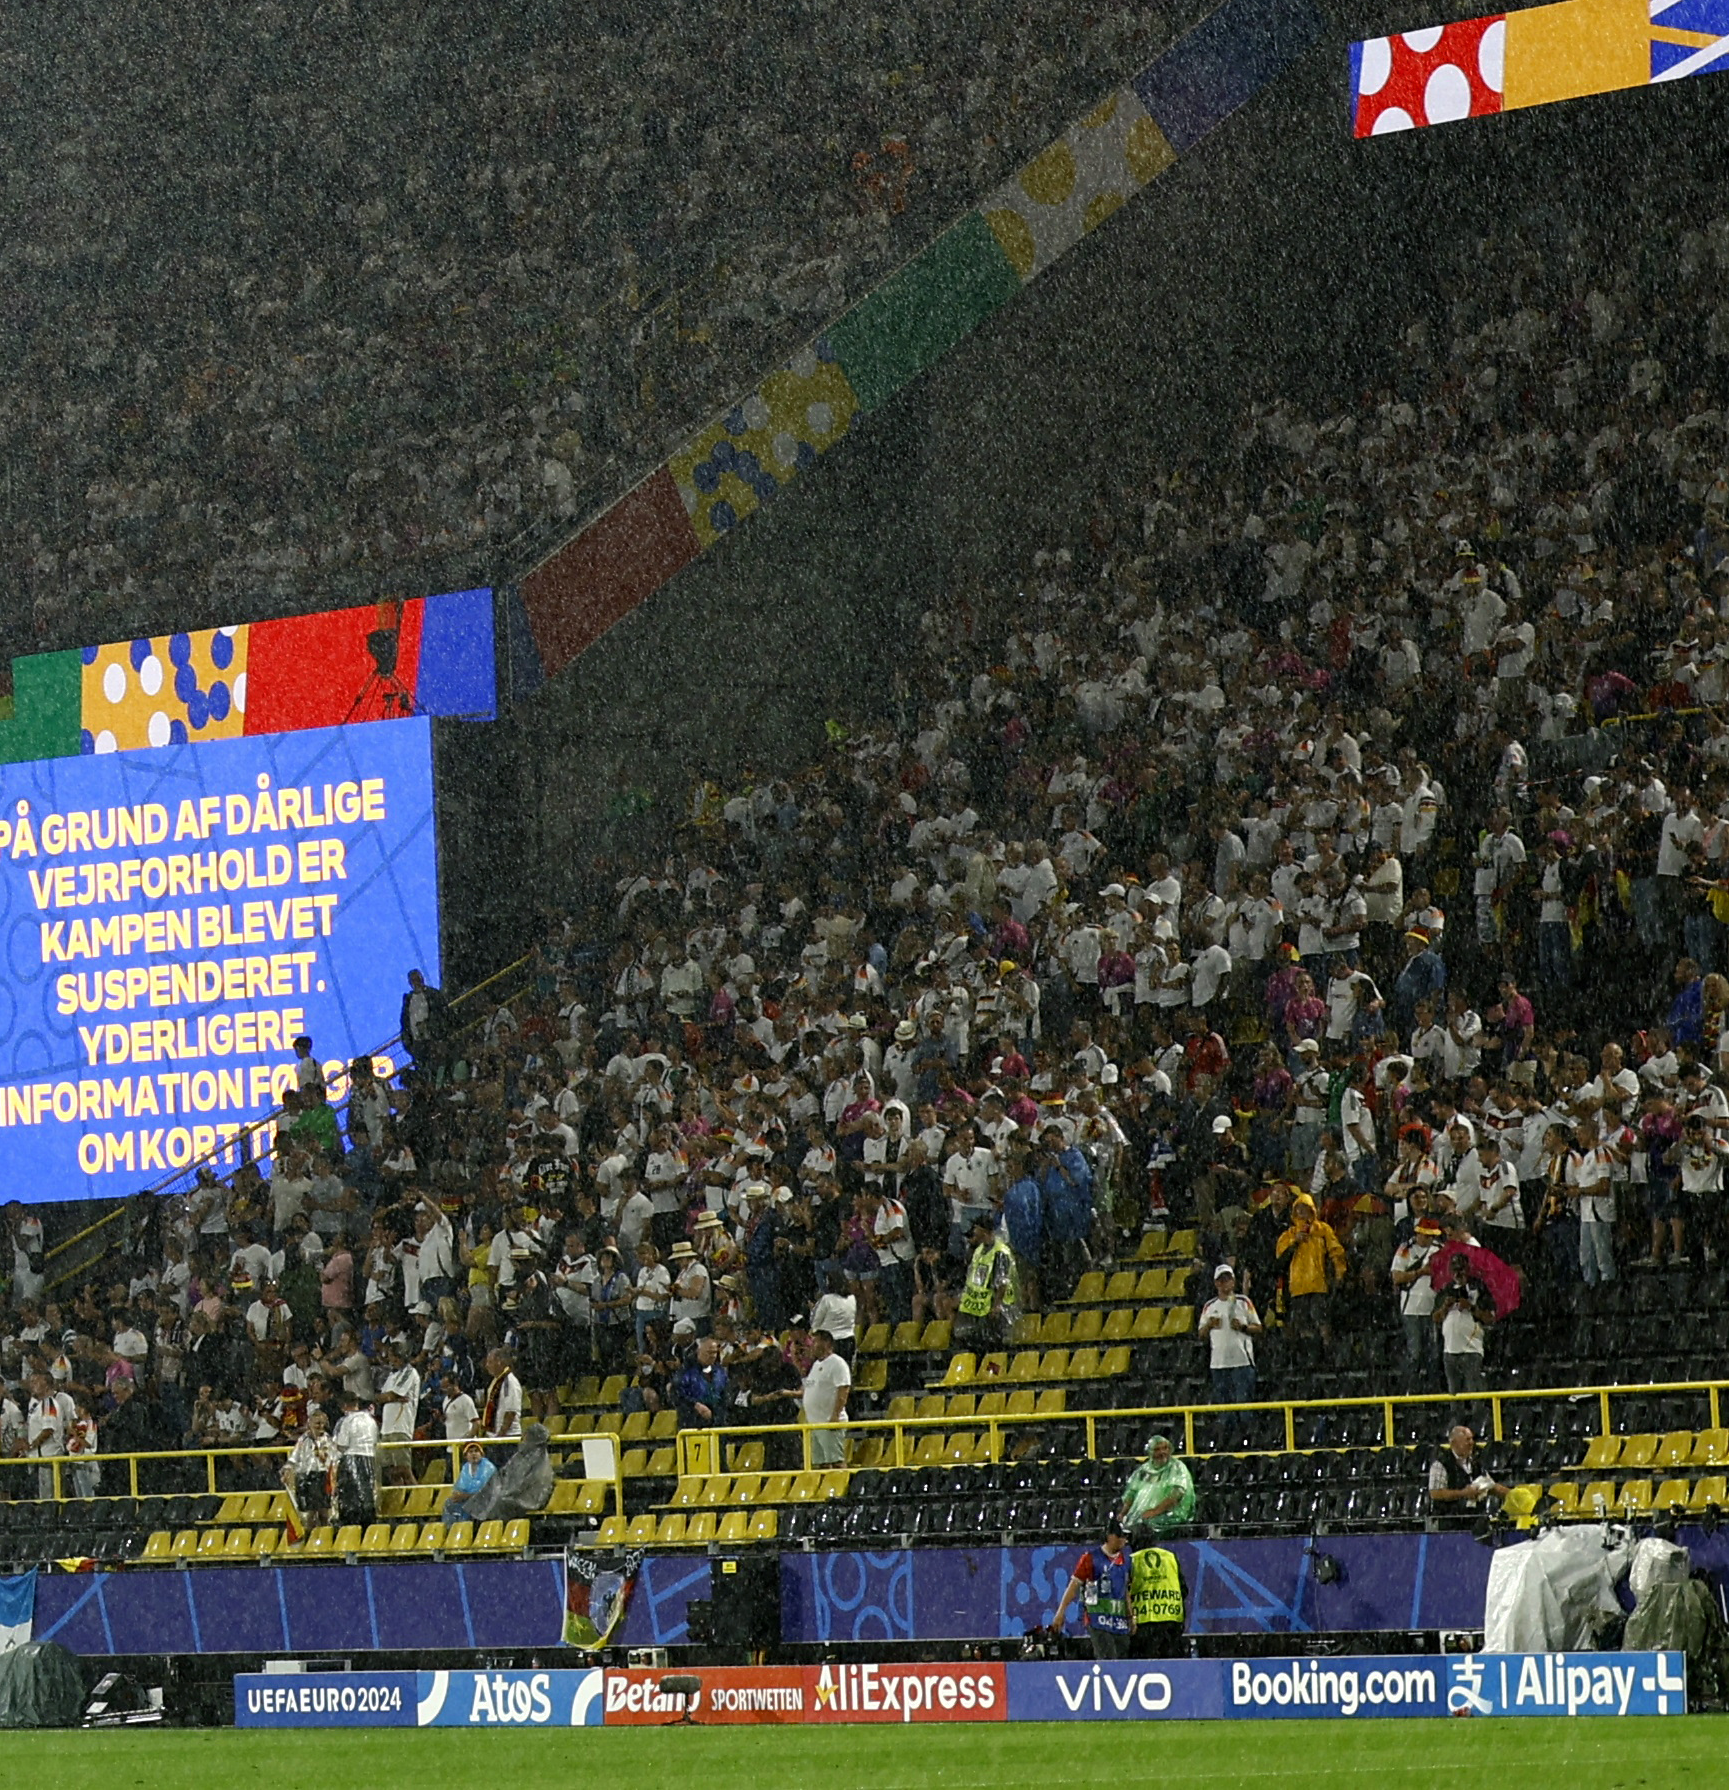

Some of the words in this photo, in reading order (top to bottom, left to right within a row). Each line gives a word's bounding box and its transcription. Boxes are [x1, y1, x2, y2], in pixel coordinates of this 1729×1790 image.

[41, 804, 168, 855] GRUND
[174, 796, 221, 841] AF
[226, 772, 386, 836] DÅRLIGE
[28, 847, 293, 909] VEJRFORHOLD
[297, 838, 346, 884] ER
[40, 909, 192, 962] KAMPEN
[198, 894, 338, 947] BLEVET
[56, 952, 326, 1015] SUSPENDERET.
[79, 1007, 305, 1066] YDERLIGERE
[78, 1130, 135, 1175] OM
[140, 1122, 233, 1170] KORT
[694, 1443, 701, 1462] 7
[710, 1687, 803, 1711] SPORTWETTEN
[814, 1663, 995, 1723] AliExpress
[1055, 1665, 1172, 1711] vivo
[1232, 1661, 1436, 1715] Booking.com
